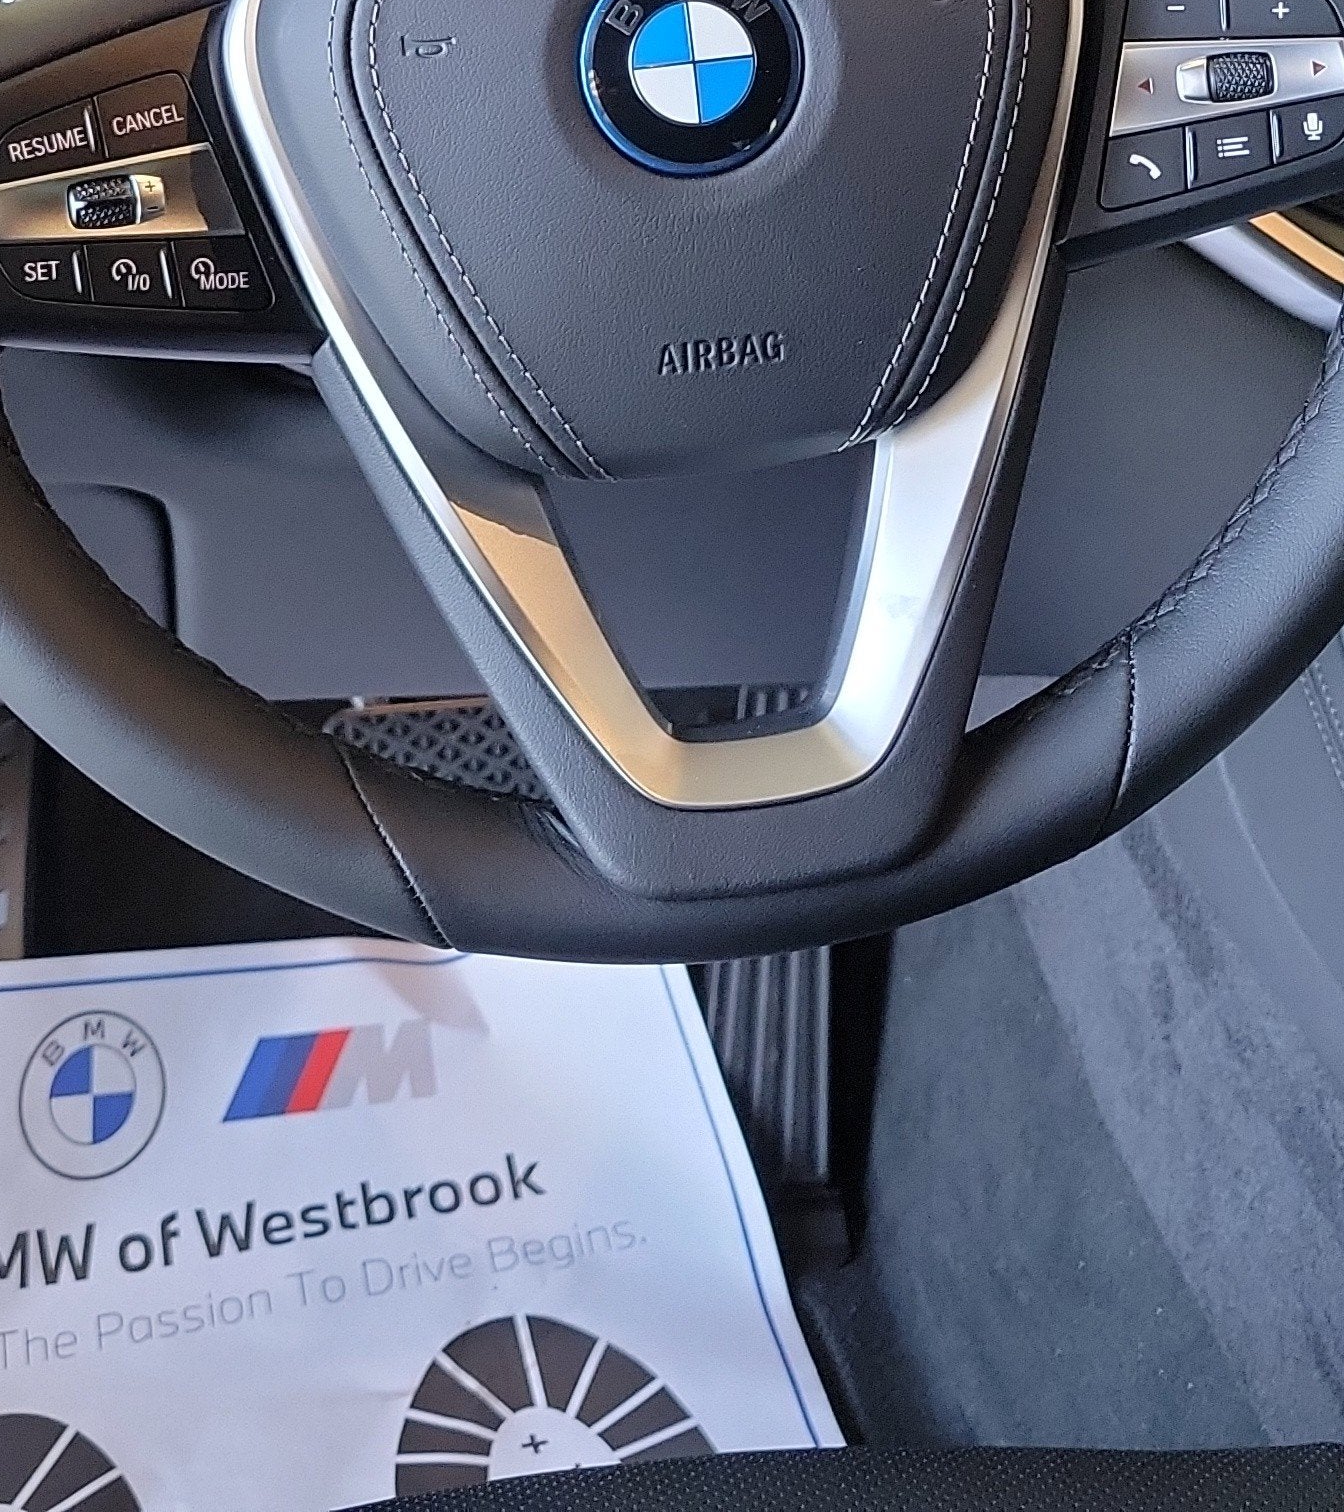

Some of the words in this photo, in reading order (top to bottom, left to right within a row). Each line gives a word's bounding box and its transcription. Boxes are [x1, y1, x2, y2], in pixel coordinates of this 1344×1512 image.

[112, 104, 185, 136] CANCEL
[8, 126, 89, 163] RESUME
[23, 261, 60, 282] SET
[200, 272, 251, 290] MODE
[658, 330, 787, 377] AIRBAG
[43, 1019, 154, 1068] BMW
[117, 1211, 180, 1275] of
[195, 1152, 549, 1259] Westbrook
[96, 1283, 273, 1351] Passion
[285, 1269, 347, 1309] To
[360, 1248, 473, 1295] Drive
[485, 1213, 649, 1272] Begins.
